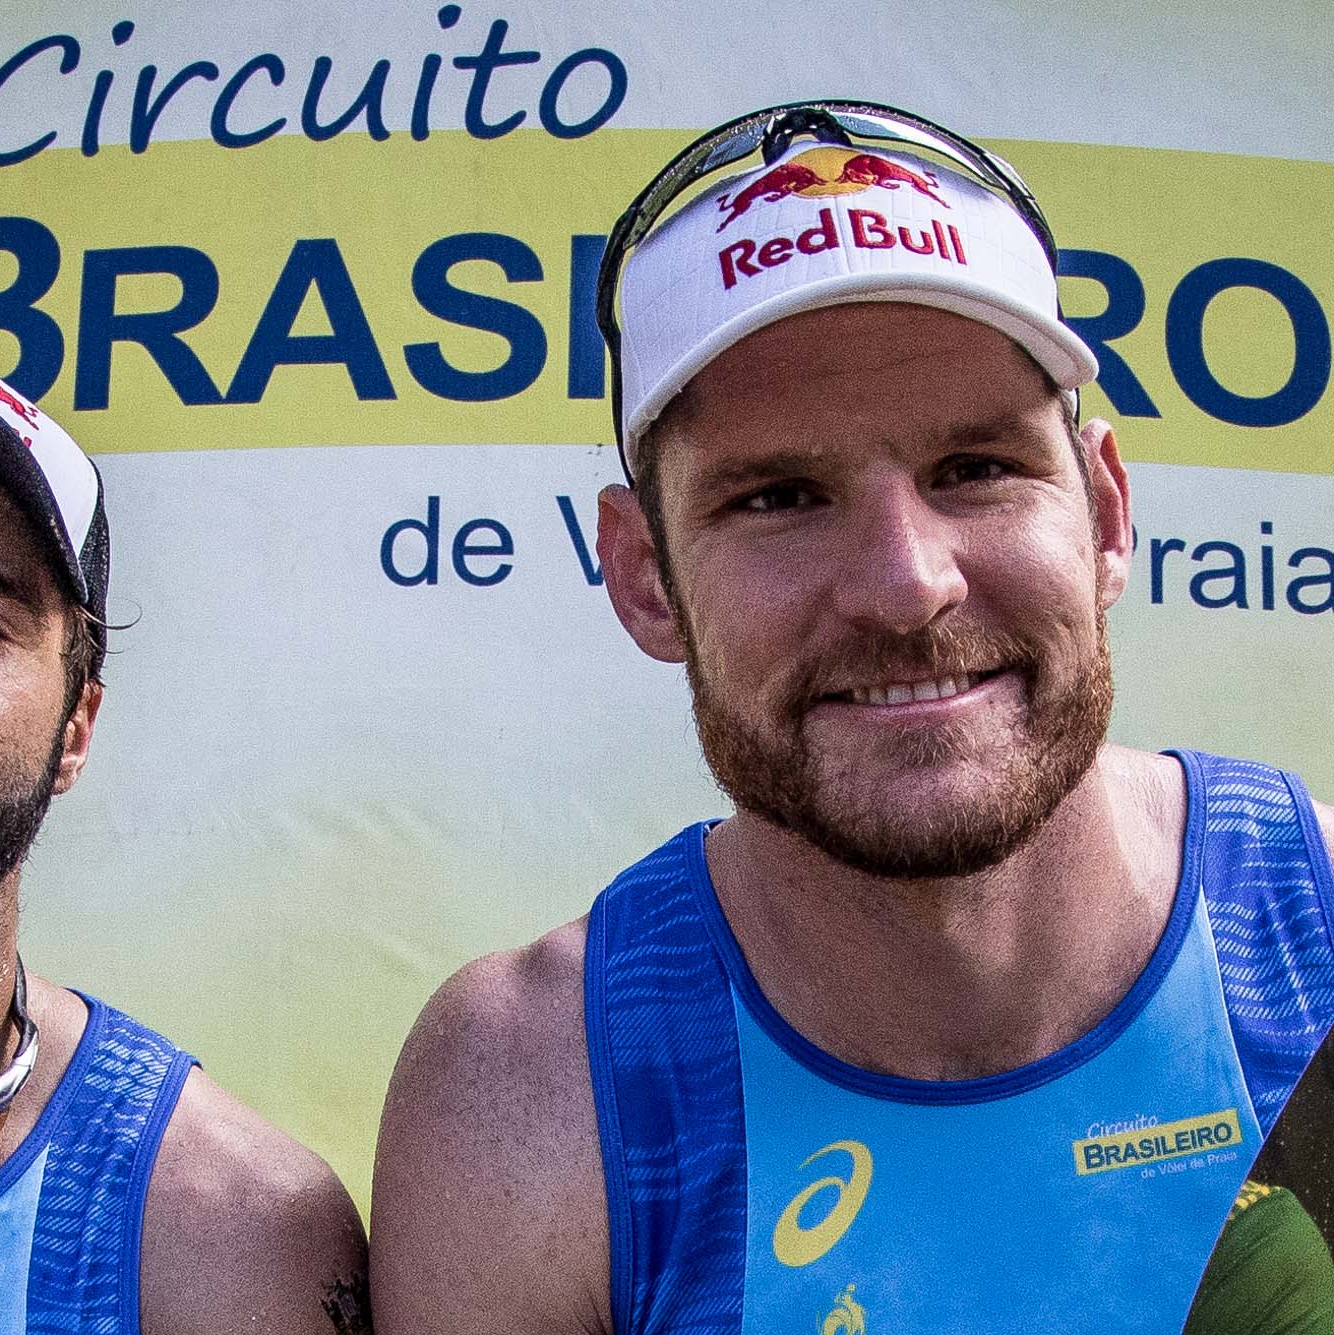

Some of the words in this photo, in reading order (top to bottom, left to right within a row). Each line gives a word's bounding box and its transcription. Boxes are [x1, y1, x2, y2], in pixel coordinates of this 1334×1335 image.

[717, 209, 838, 290] Red
[849, 208, 968, 266] Bull
[381, 496, 515, 587] de
[1083, 1122, 1233, 1169] BRASILEIRO
[1086, 1113, 1158, 1140] Circuito
